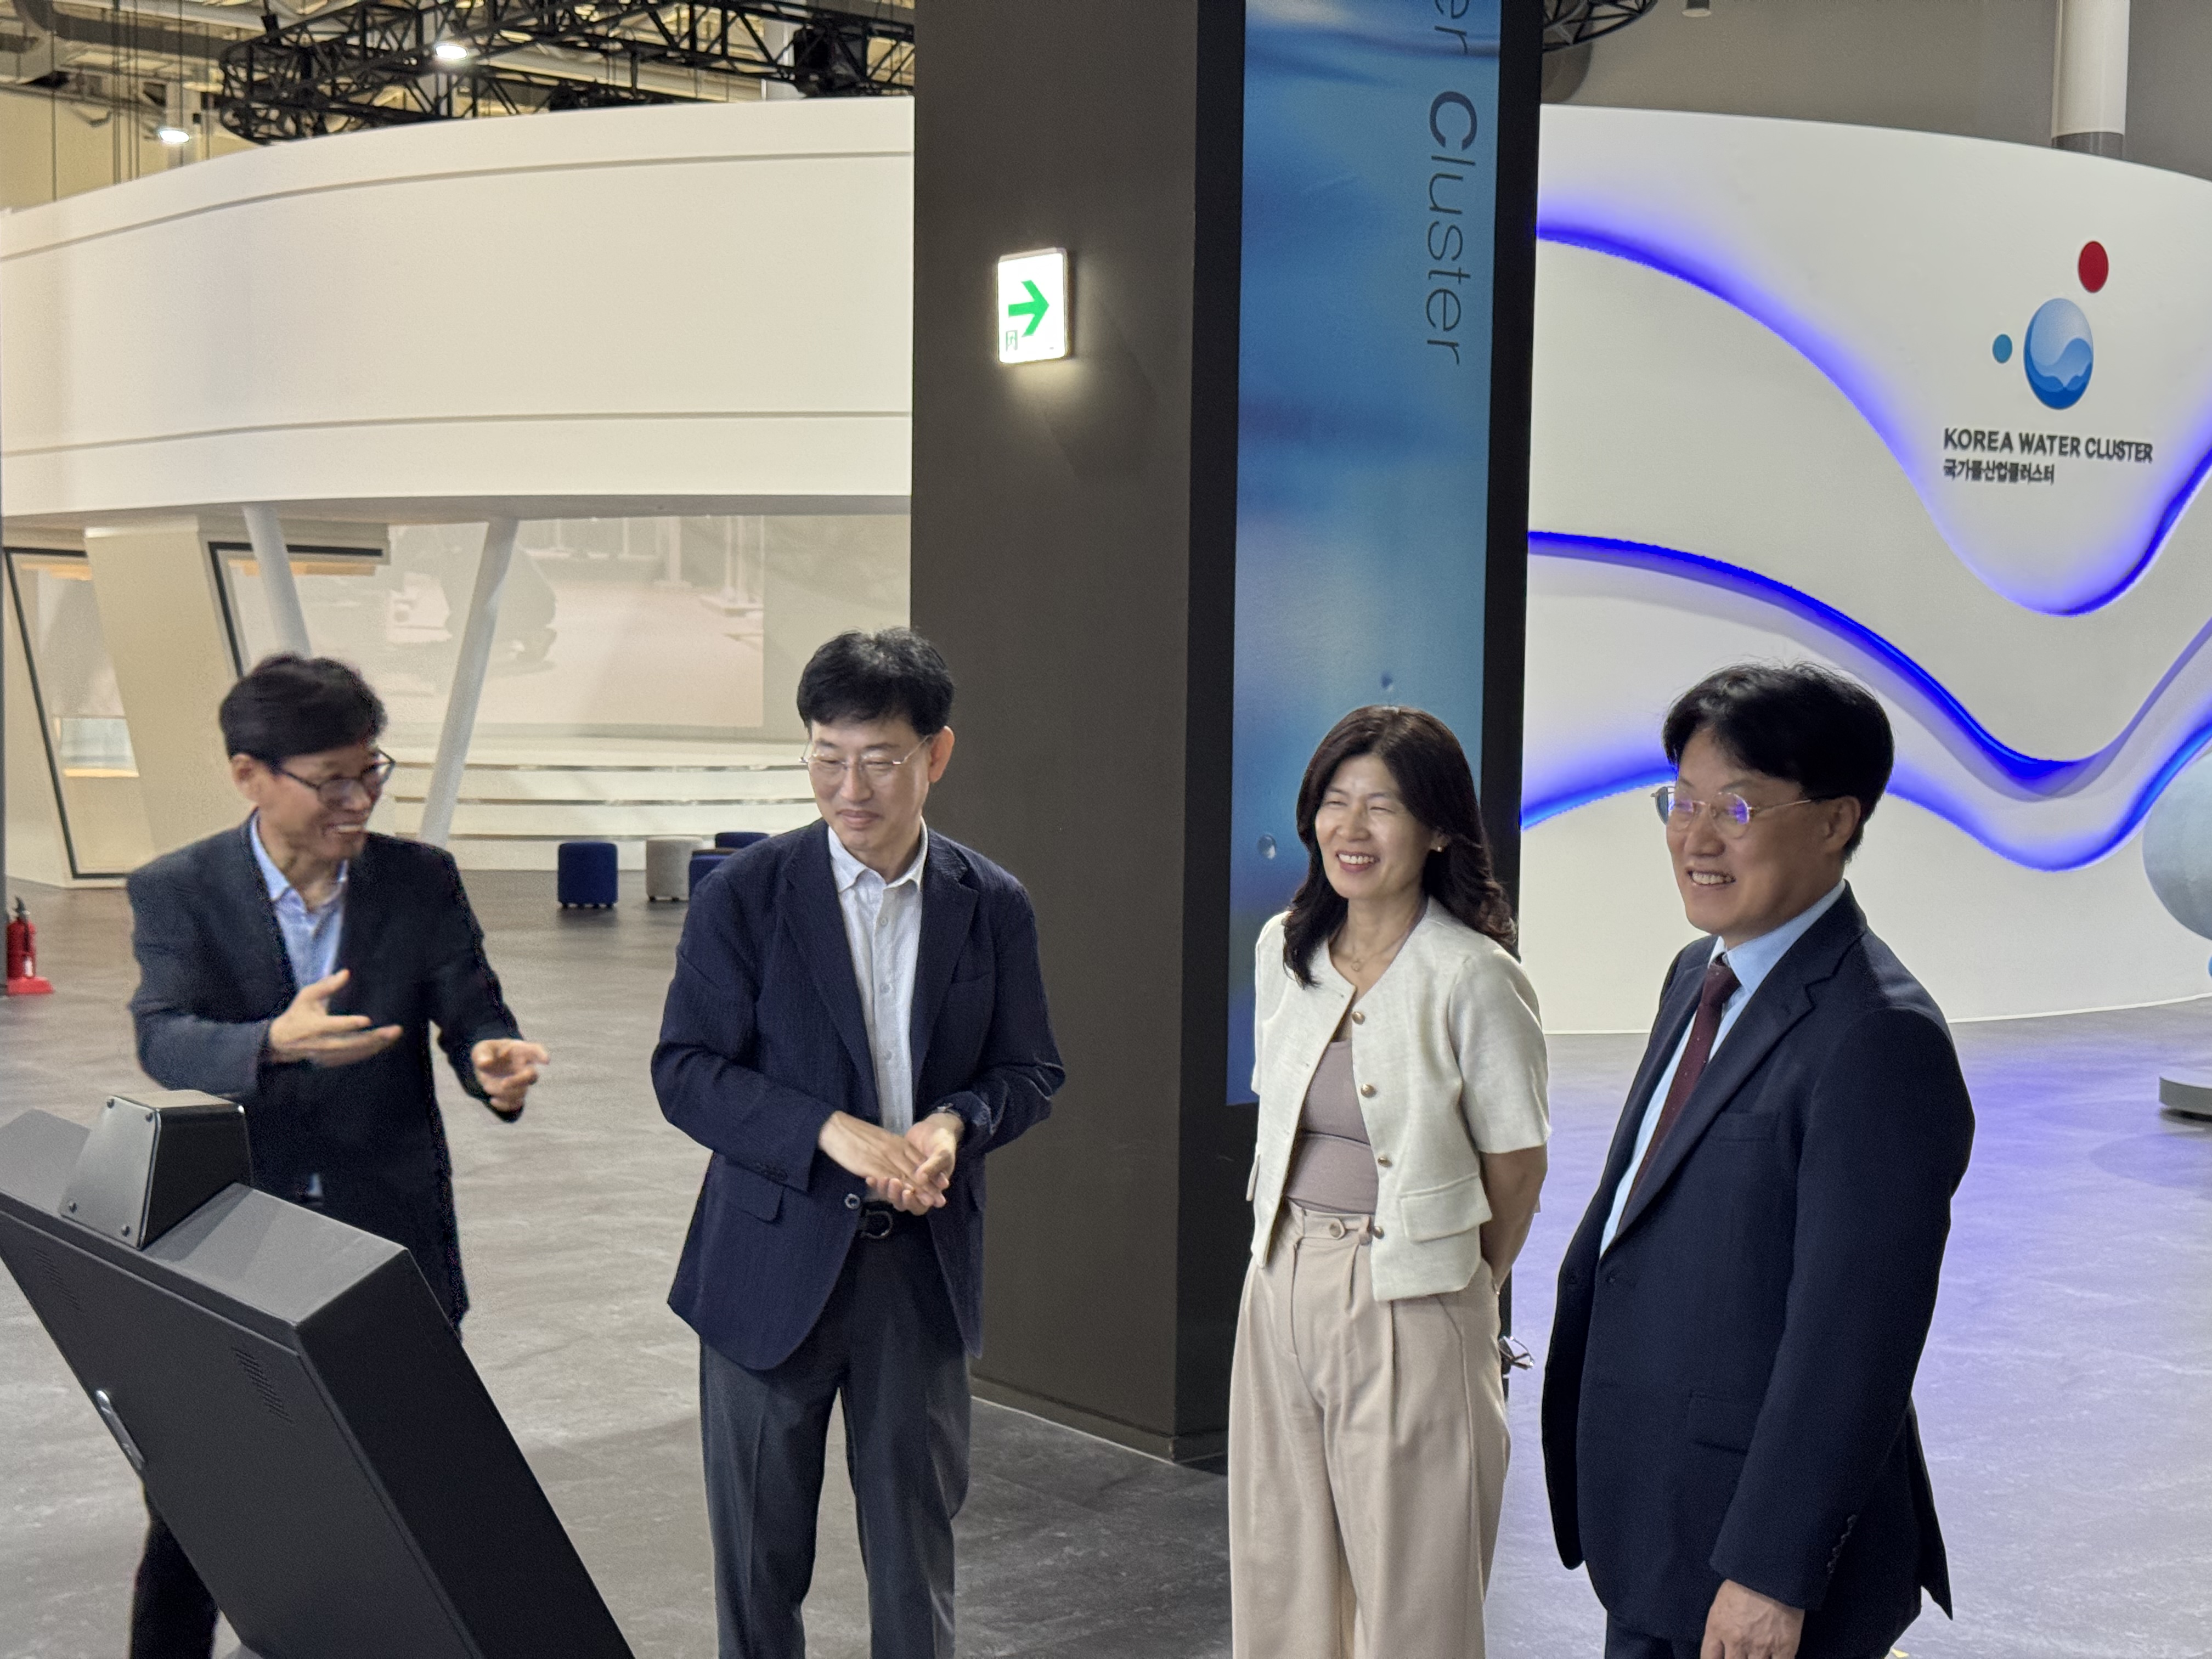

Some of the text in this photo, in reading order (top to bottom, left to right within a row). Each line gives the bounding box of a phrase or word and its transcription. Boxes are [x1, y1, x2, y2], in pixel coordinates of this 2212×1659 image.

[1426, 91, 1478, 365] Cluster
[1943, 428, 2154, 464] KOREA WATER CLUSTER
[1943, 458, 2056, 485] 국가물산업클러스터
